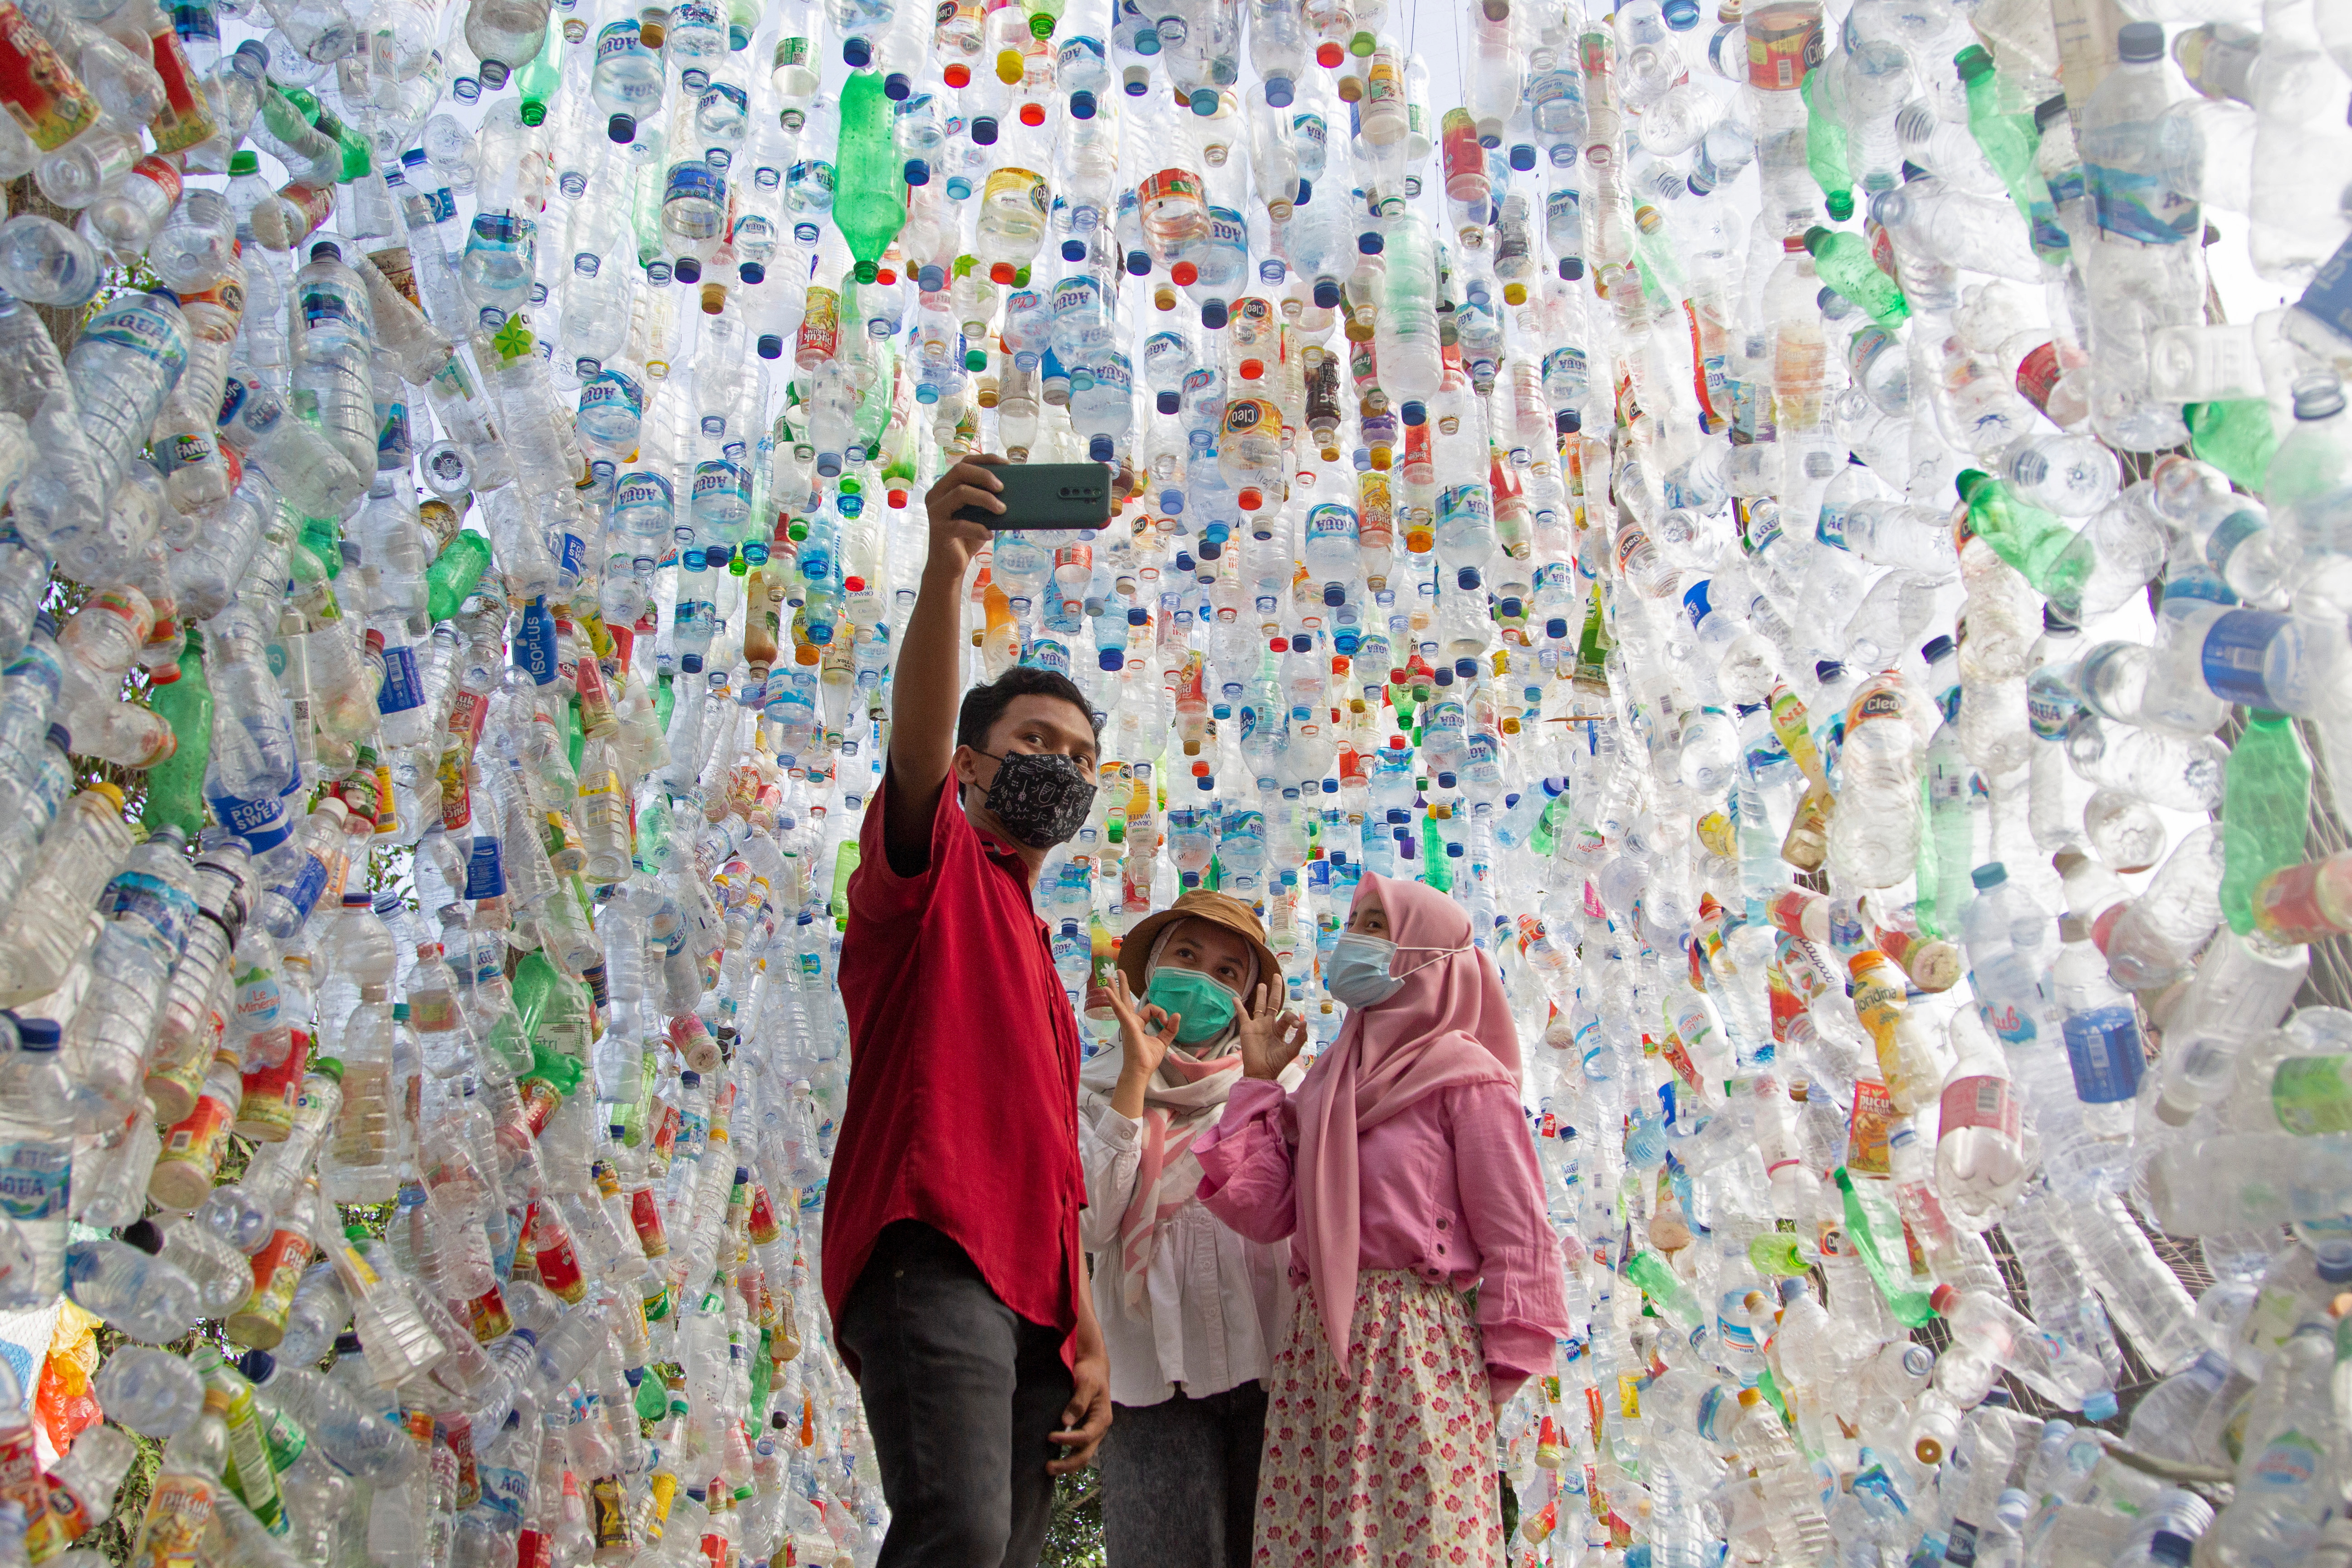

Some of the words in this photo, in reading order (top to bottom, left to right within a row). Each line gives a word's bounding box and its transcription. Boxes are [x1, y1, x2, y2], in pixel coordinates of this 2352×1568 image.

[745, 222, 768, 232] AQUA
[1008, 295, 1038, 312] Club
[1053, 292, 1090, 314] AQUA
[1247, 304, 1263, 315] Cleo
[1145, 343, 1169, 360] AQUA
[1097, 365, 1130, 387] AQUA
[1183, 372, 1210, 393] Club
[582, 387, 617, 407] AQUA
[1231, 409, 1254, 422] Cleo
[174, 439, 211, 460] FANTA
[693, 475, 728, 493] AQUA
[619, 488, 657, 504] AQUA
[1133, 521, 1144, 531] Cleo
[1316, 517, 1352, 533] AQUA
[1621, 535, 1641, 554] Cleo
[527, 616, 546, 676] ISOPLUS
[1040, 652, 1068, 670] AQUA
[1867, 696, 1900, 711] Cleo
[1128, 819, 1152, 827] ORANGE
[252, 990, 267, 1001] Le
[1687, 1023, 1697, 1034] Le
